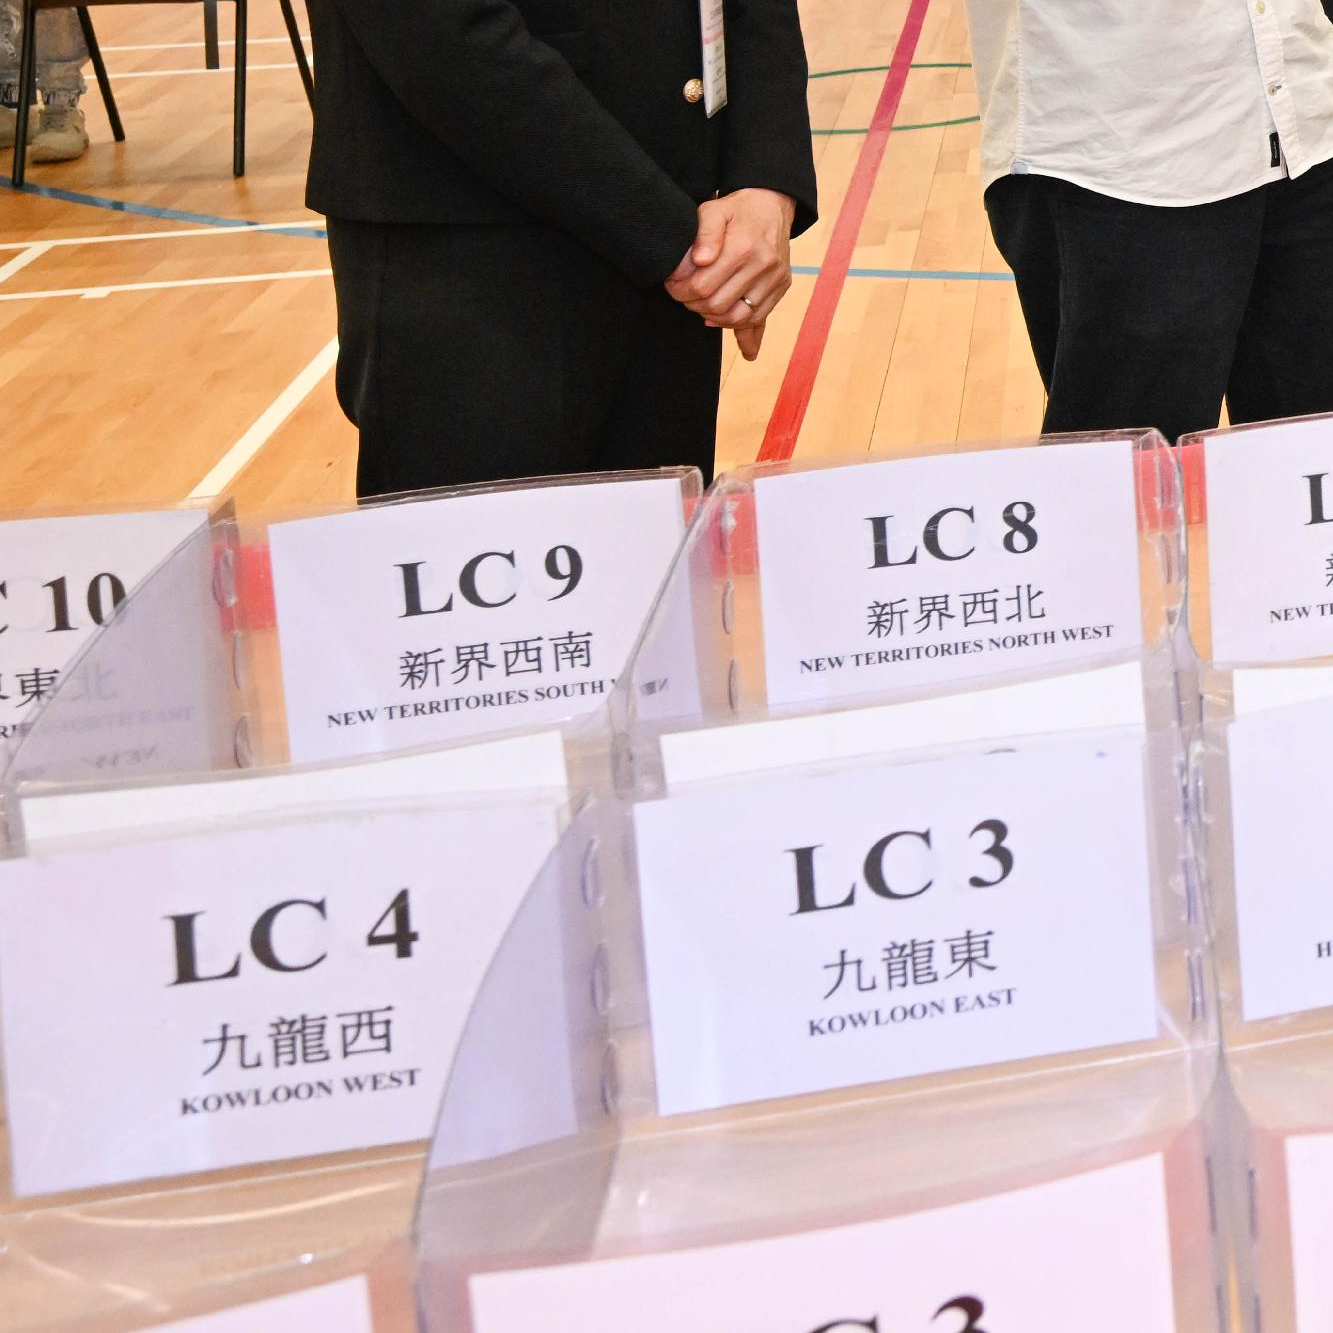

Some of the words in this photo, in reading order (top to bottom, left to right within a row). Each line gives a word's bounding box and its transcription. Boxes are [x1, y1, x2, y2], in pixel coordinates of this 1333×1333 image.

[864, 505, 976, 569] LC
[1001, 501, 1039, 555] 8
[41, 572, 127, 632] 10
[394, 550, 516, 617] LC
[545, 545, 583, 601] 9
[867, 585, 1046, 638] 新界西北
[1269, 605, 1312, 624] NEW
[400, 631, 593, 690] 新界西南
[800, 656, 847, 674] NEW
[851, 640, 984, 668] TERRITORIES
[988, 631, 1057, 651] NORTH
[1062, 624, 1115, 643] WEST
[328, 709, 377, 727] NEW
[384, 690, 529, 719] TERRITORIES
[534, 680, 605, 701] SOUTH
[784, 827, 934, 916] LC
[968, 818, 1015, 889] 3
[163, 898, 328, 987] LC
[366, 887, 419, 959] 4
[822, 929, 997, 1000] 九龍東
[201, 1005, 396, 1077] 九龍西
[809, 998, 946, 1037] KOWLOON
[954, 988, 1017, 1015] EAST
[180, 1078, 335, 1116] KOWLOON
[342, 1066, 421, 1095] WEST
